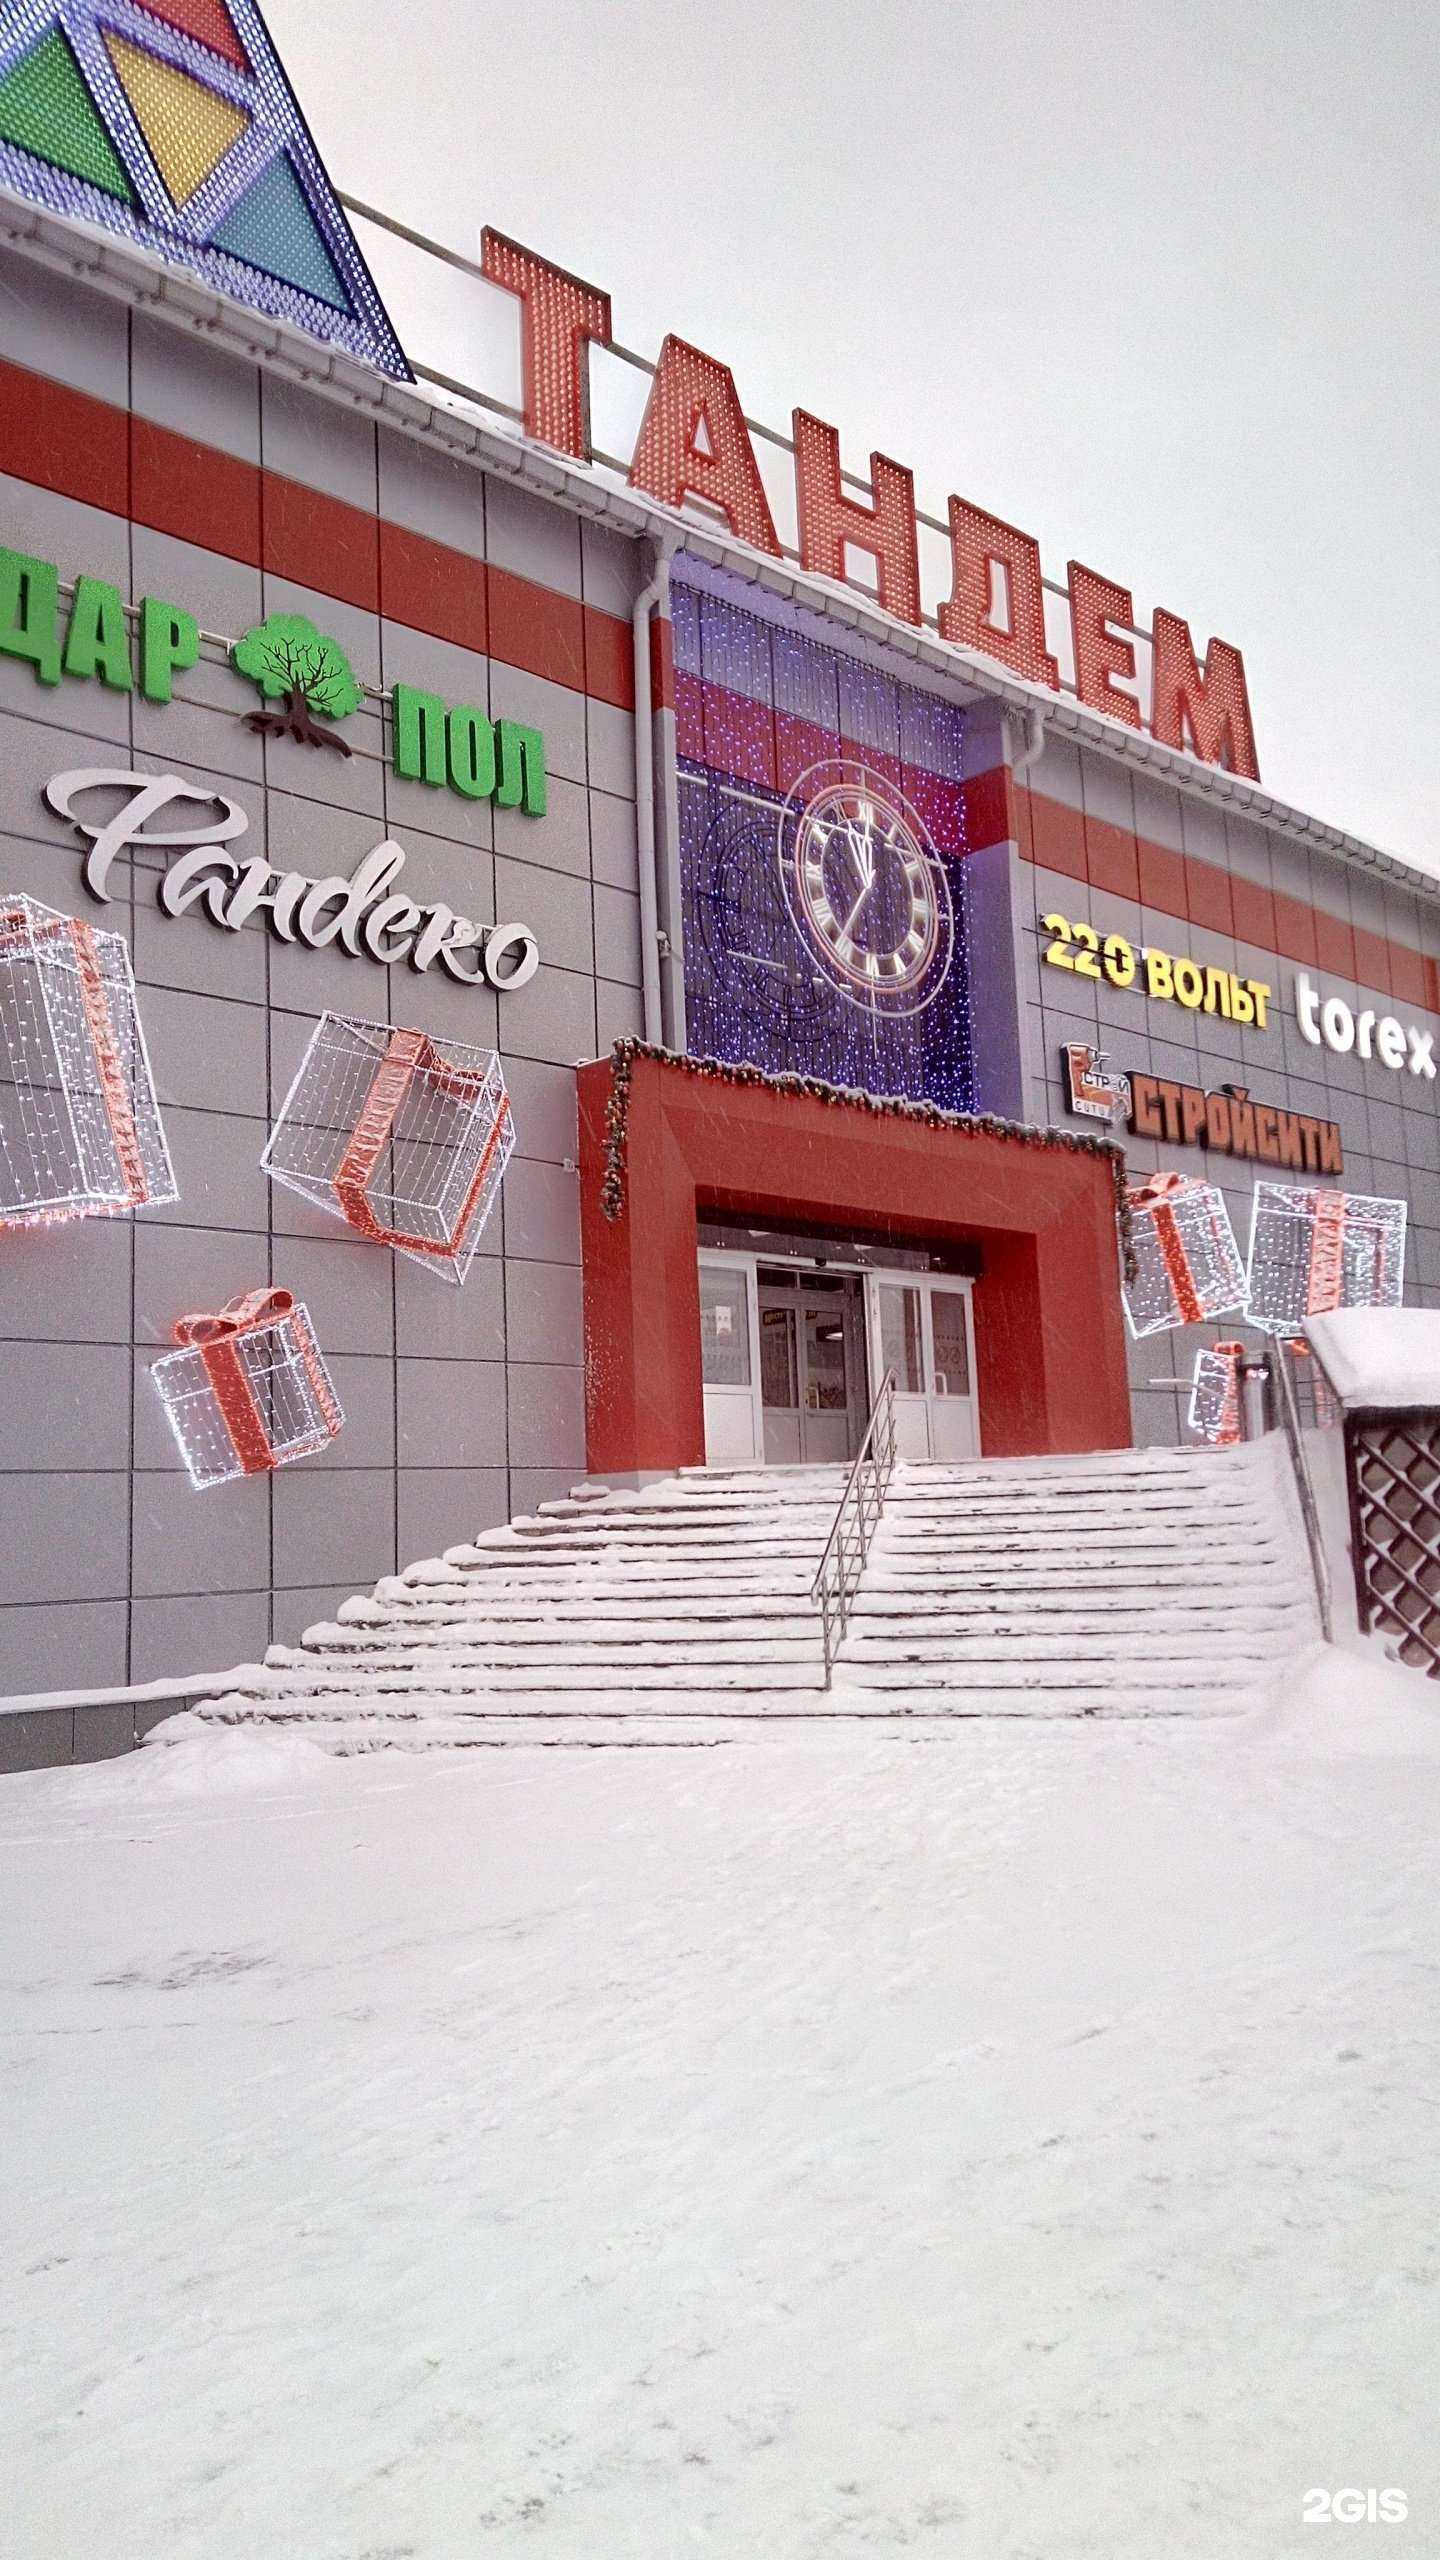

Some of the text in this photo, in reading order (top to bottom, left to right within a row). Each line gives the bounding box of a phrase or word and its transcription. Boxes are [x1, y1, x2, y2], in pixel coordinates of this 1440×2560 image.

[480, 225, 1262, 784] ТАНДЕМ
[392, 683, 547, 817] ПОЛ
[42, 767, 540, 991] Рандеко
[1040, 913, 1272, 1031] 220 ВОЛЬТ
[1295, 972, 1437, 1079] torex
[1127, 1069, 1344, 1175] СТРОЙСИТИ
